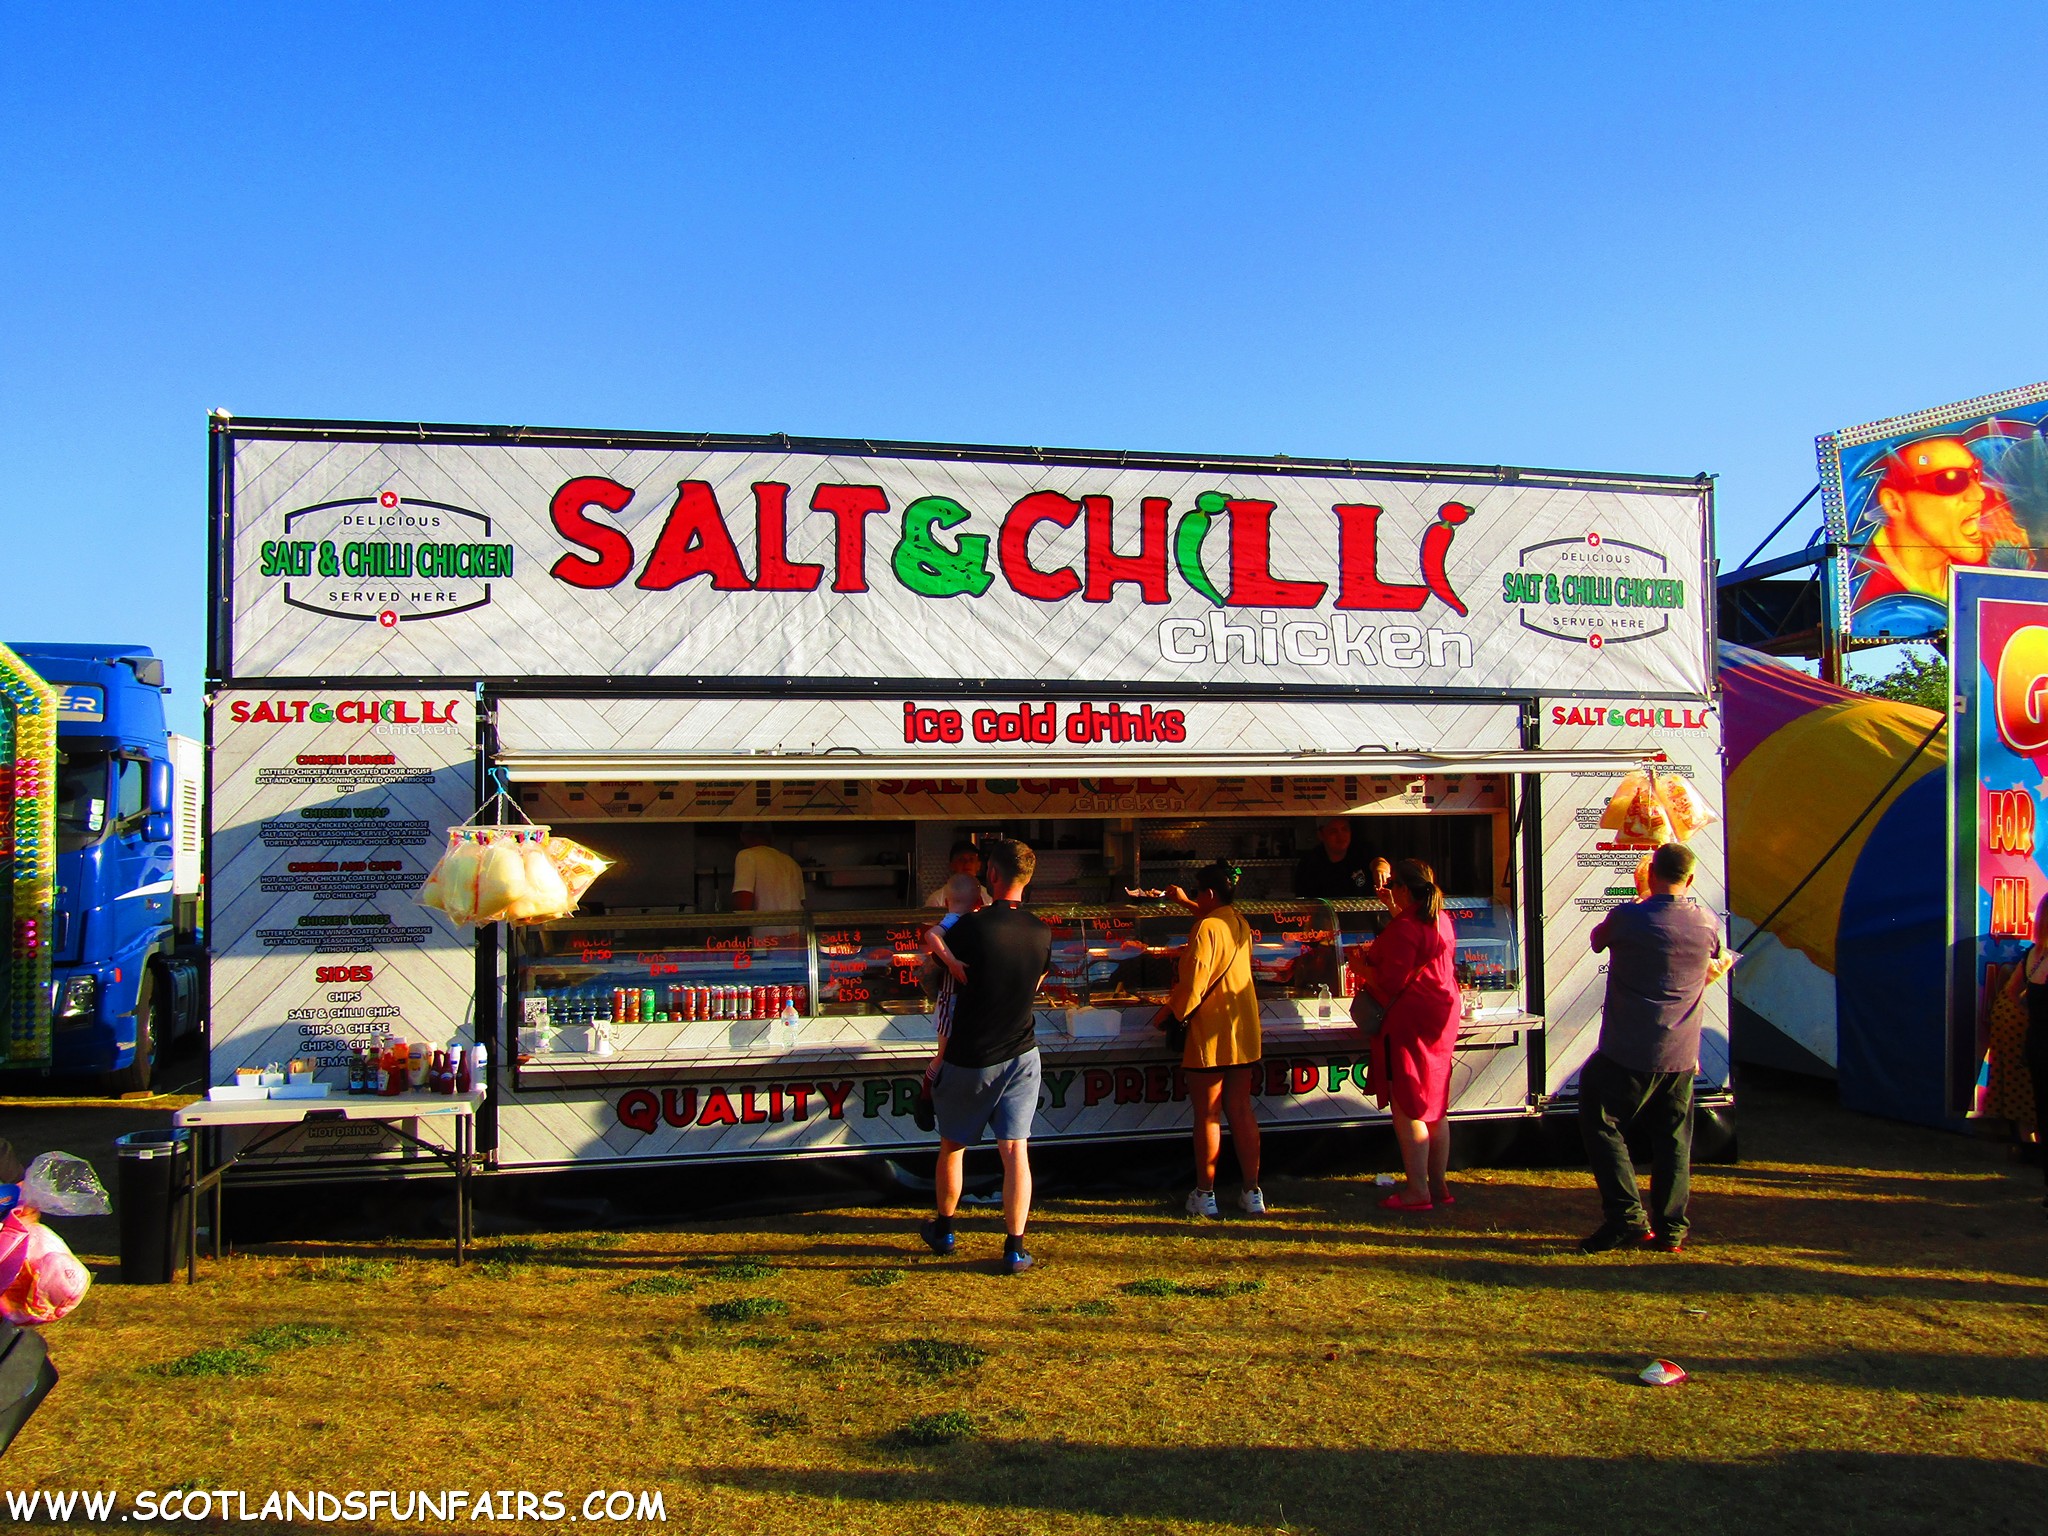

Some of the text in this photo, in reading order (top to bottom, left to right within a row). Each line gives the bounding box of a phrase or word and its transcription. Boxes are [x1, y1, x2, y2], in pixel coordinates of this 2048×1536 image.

[343, 516, 441, 526] DELICIOUS
[261, 540, 514, 578] SALT & CHILLI CHICKEN
[1562, 552, 1631, 564] DELICIOUS
[1502, 573, 1684, 608] SALT & CHILLI CHICKEN
[329, 592, 457, 602] SERVED HERE
[1553, 617, 1645, 629] SERVED HERE
[1158, 610, 1474, 668] chicken
[57, 696, 96, 712] ER
[904, 702, 1186, 744] ice cold drinks
[376, 724, 460, 735] chicken
[1652, 728, 1709, 738] chicken
[297, 755, 396, 765] CHICKEN BURGER
[260, 768, 432, 776] BATTERED CHICKEN FILLET COATED IN OUR HOUSE
[256, 776, 435, 784] SALT AND CHILLI SEASONING SERVED ON A BRIOCHE
[338, 785, 355, 793] BUN
[1075, 795, 1186, 812] chicken
[302, 808, 389, 818] CHICKEN WRAP
[262, 822, 278, 830] HOT
[348, 821, 376, 829] COATED
[377, 821, 386, 829] IN
[386, 821, 403, 829] OUR
[404, 821, 428, 829] HOUSE
[1988, 790, 2034, 854] FOR
[295, 830, 318, 838] CHILLI
[299, 839, 322, 847] WRAP
[402, 838, 426, 846] SALAD
[288, 861, 402, 872] CHICKEN AND CHIPS
[261, 874, 402, 883] HOT AND SPICY CHICKEN COATED IN OUR
[320, 883, 361, 891] SEASONING
[1604, 887, 1638, 896] CHICKEN
[314, 892, 331, 900] AND
[1990, 876, 2032, 939] ALL
[298, 915, 390, 926] CHICKEN WINGS
[1094, 917, 1112, 929] Hot
[1273, 912, 1311, 926] Burger
[294, 928, 325, 936] CHICKEN
[352, 927, 380, 935] COATED
[407, 926, 432, 934] HOUSE
[887, 929, 912, 940] Salt
[264, 938, 282, 946] SALT
[821, 931, 850, 944] Salt
[895, 940, 918, 951] Chilli
[638, 953, 667, 965] Cans
[1464, 948, 1488, 961] Water
[734, 954, 751, 969] £3
[316, 966, 373, 982] SIDES
[900, 970, 919, 987] £4
[327, 992, 362, 1002] CHIPS
[288, 1006, 400, 1019] SALT & CHILLI CHIPS
[298, 1023, 389, 1036] CHIPS & CHEESE
[300, 1041, 335, 1052] CHIPS
[336, 1040, 347, 1050] &
[617, 1081, 855, 1134] QUALITY
[309, 1126, 378, 1138] HOT DRINKS
